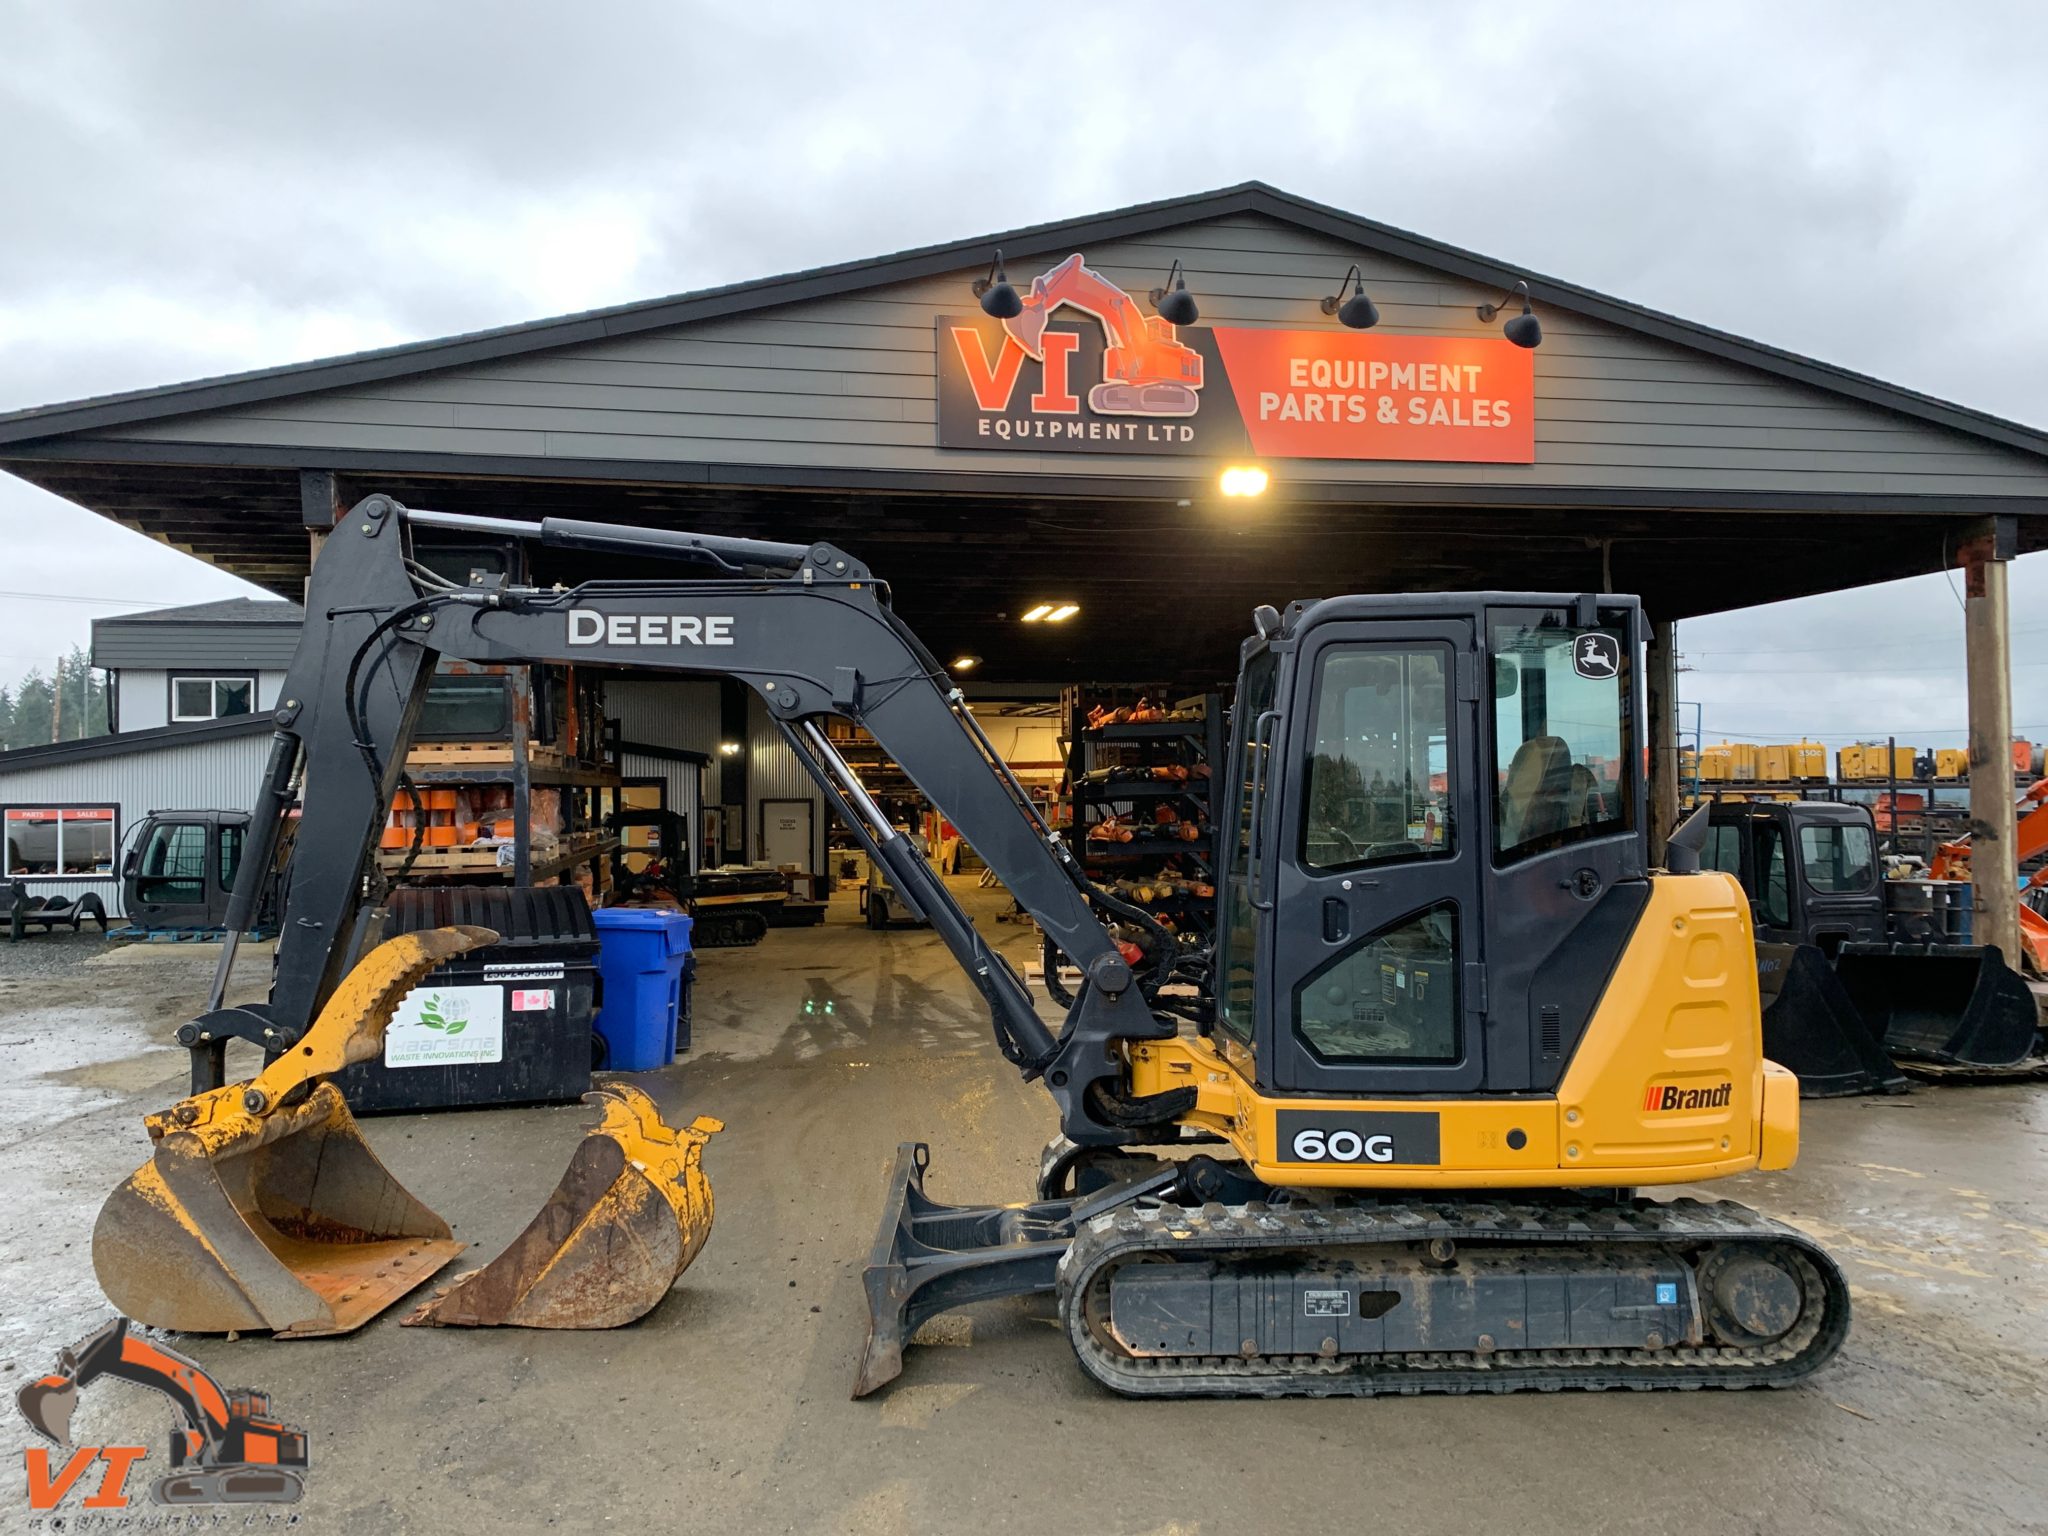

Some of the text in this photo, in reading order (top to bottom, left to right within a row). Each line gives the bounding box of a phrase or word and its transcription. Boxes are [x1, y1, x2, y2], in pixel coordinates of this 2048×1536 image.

[950, 326, 1081, 415] VI
[1290, 357, 1483, 394] EQUIPMENT
[1259, 391, 1512, 428] PARTS & SALES
[978, 418, 1195, 442] EQUIPMENT LTD
[568, 609, 734, 646] DEERE
[391, 1053, 421, 1062] WASTE
[422, 1050, 479, 1060] INNOVATIONS
[1660, 1083, 1732, 1111] Brandt
[1292, 1128, 1395, 1163] 60G
